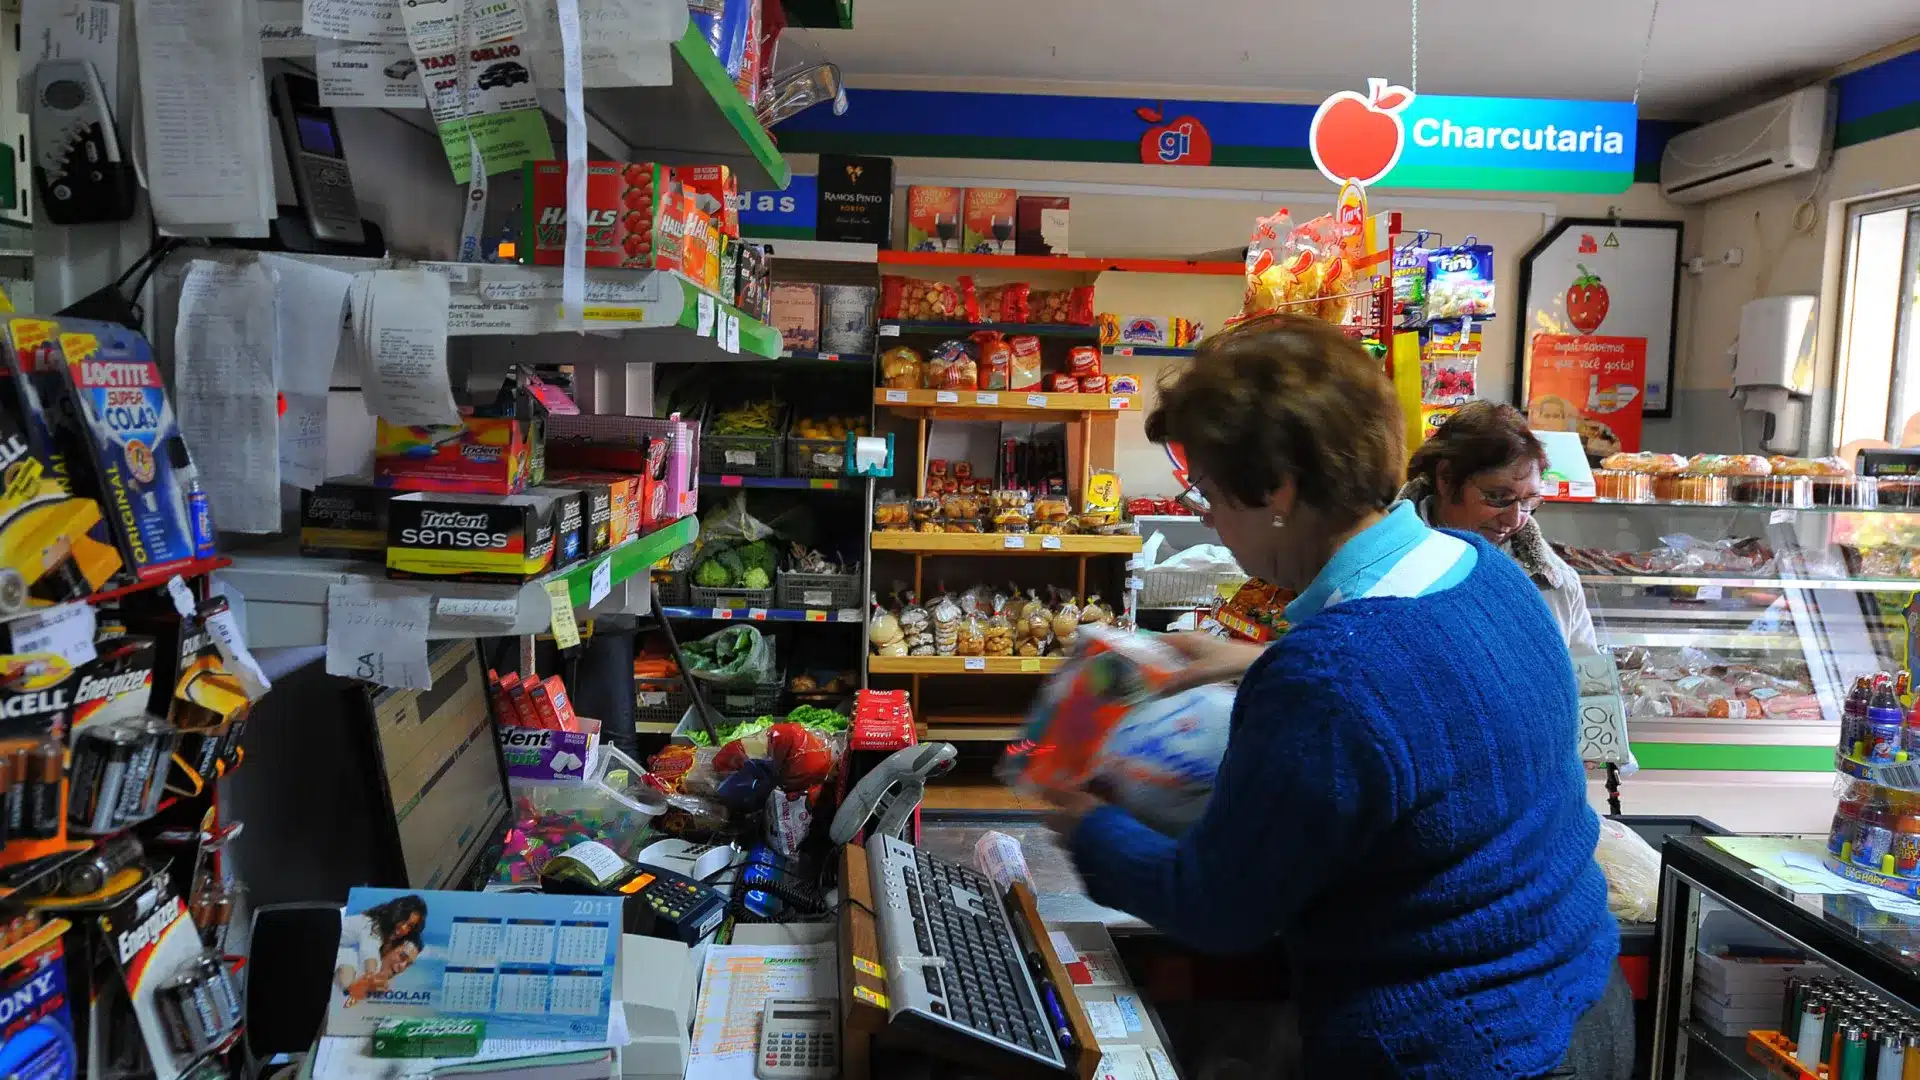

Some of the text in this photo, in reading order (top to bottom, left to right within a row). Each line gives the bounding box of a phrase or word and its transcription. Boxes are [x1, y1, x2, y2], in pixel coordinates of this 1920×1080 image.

[1158, 123, 1192, 162] gi
[1413, 117, 1624, 154] Charcutaria
[824, 192, 882, 204] RAMOS PINTO
[840, 205, 865, 213] PORTO
[1440, 254, 1474, 272] Fini
[1579, 357, 1600, 370] você
[81, 362, 150, 386] LOCTITE
[107, 390, 144, 406] SUPER
[420, 510, 489, 530] Trident
[401, 528, 508, 549] senses
[73, 668, 152, 704] Energizer
[500, 728, 551, 748] dent
[572, 900, 613, 916] 2011
[117, 895, 179, 965] Energizer
